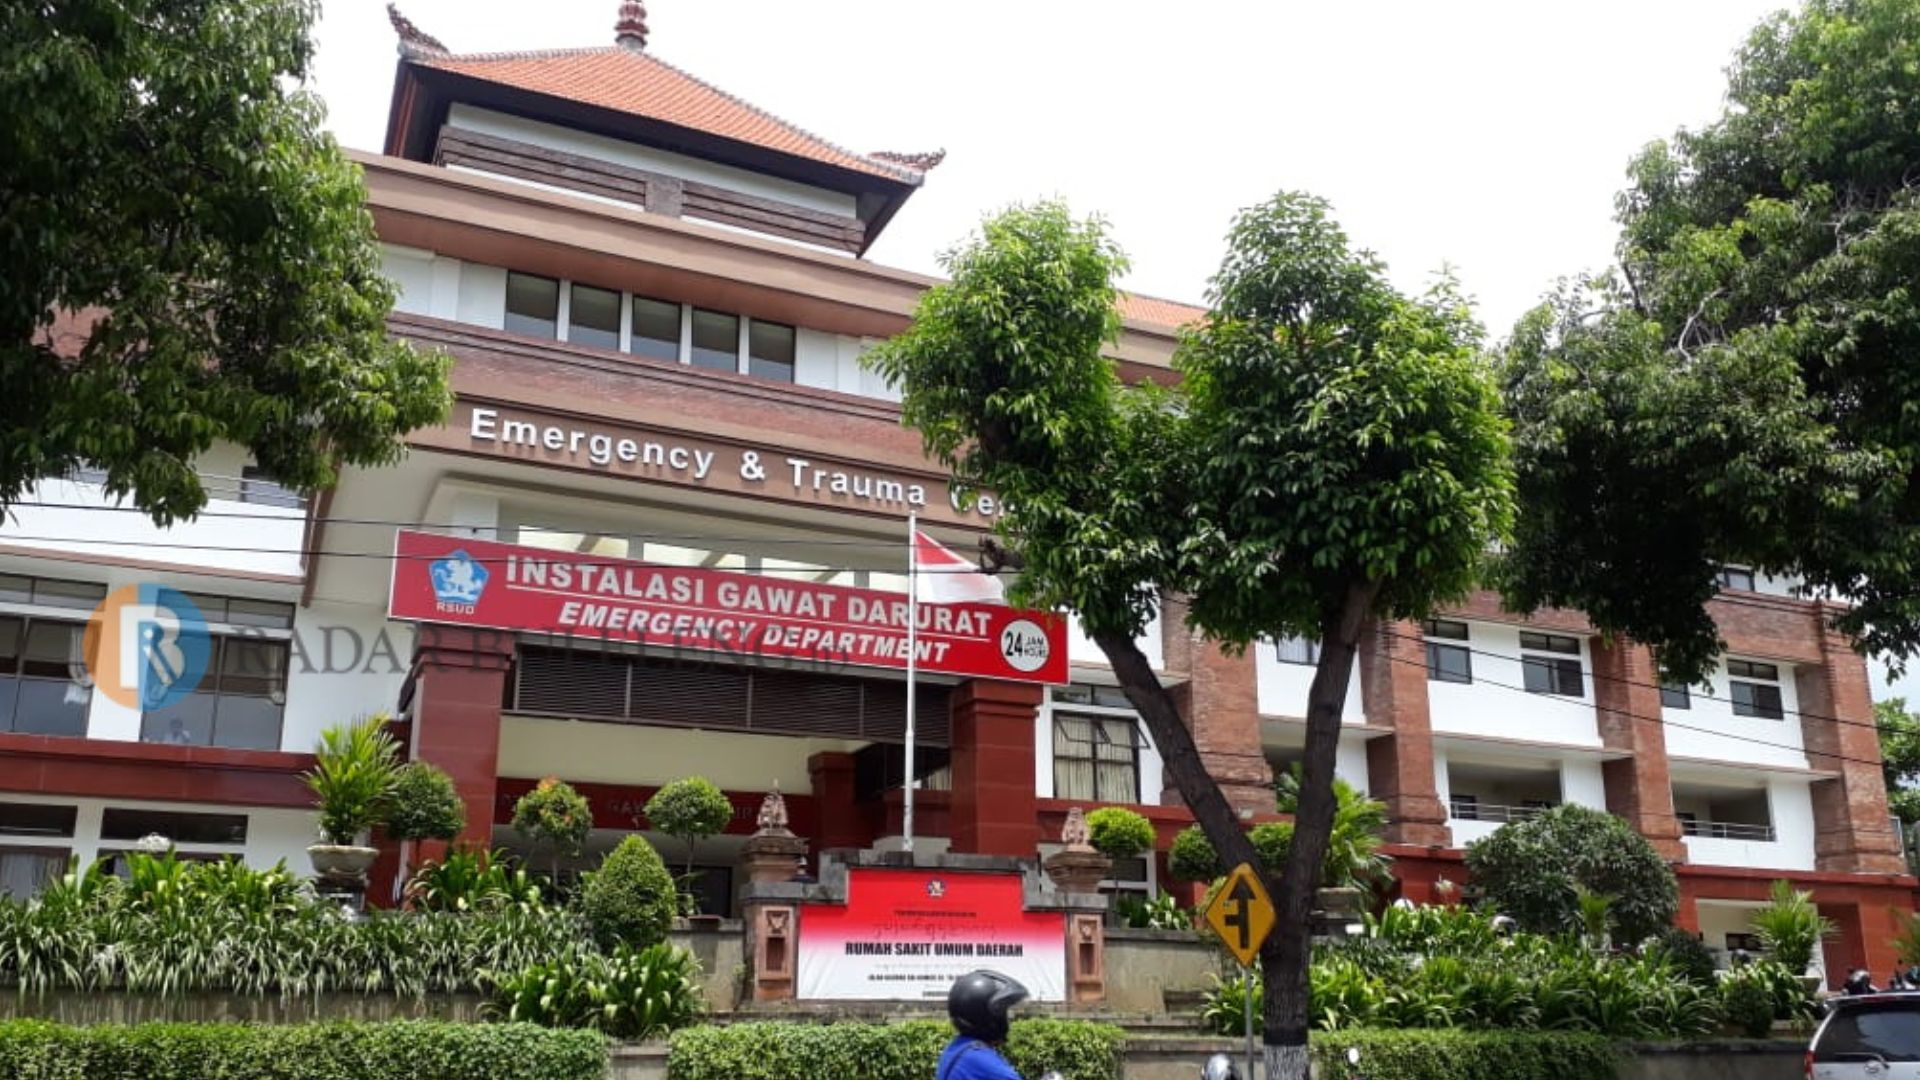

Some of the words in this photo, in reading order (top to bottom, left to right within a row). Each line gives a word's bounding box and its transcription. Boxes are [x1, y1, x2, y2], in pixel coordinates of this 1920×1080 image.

[470, 408, 714, 479] Emergency
[740, 451, 765, 481] &
[787, 459, 925, 505] Trauma
[436, 602, 475, 615] RSUD
[506, 554, 703, 605] INSTALASI
[717, 581, 837, 619] GAWAT
[848, 597, 992, 637] DARURAT
[558, 601, 757, 643] EMERGENCY
[762, 625, 951, 664] DEPARTMENT
[1005, 631, 1023, 658] 24
[845, 941, 892, 956] RUMAH
[894, 942, 931, 956] SAKIT
[934, 943, 974, 957] UMUM
[976, 943, 1023, 957] DAERAH
